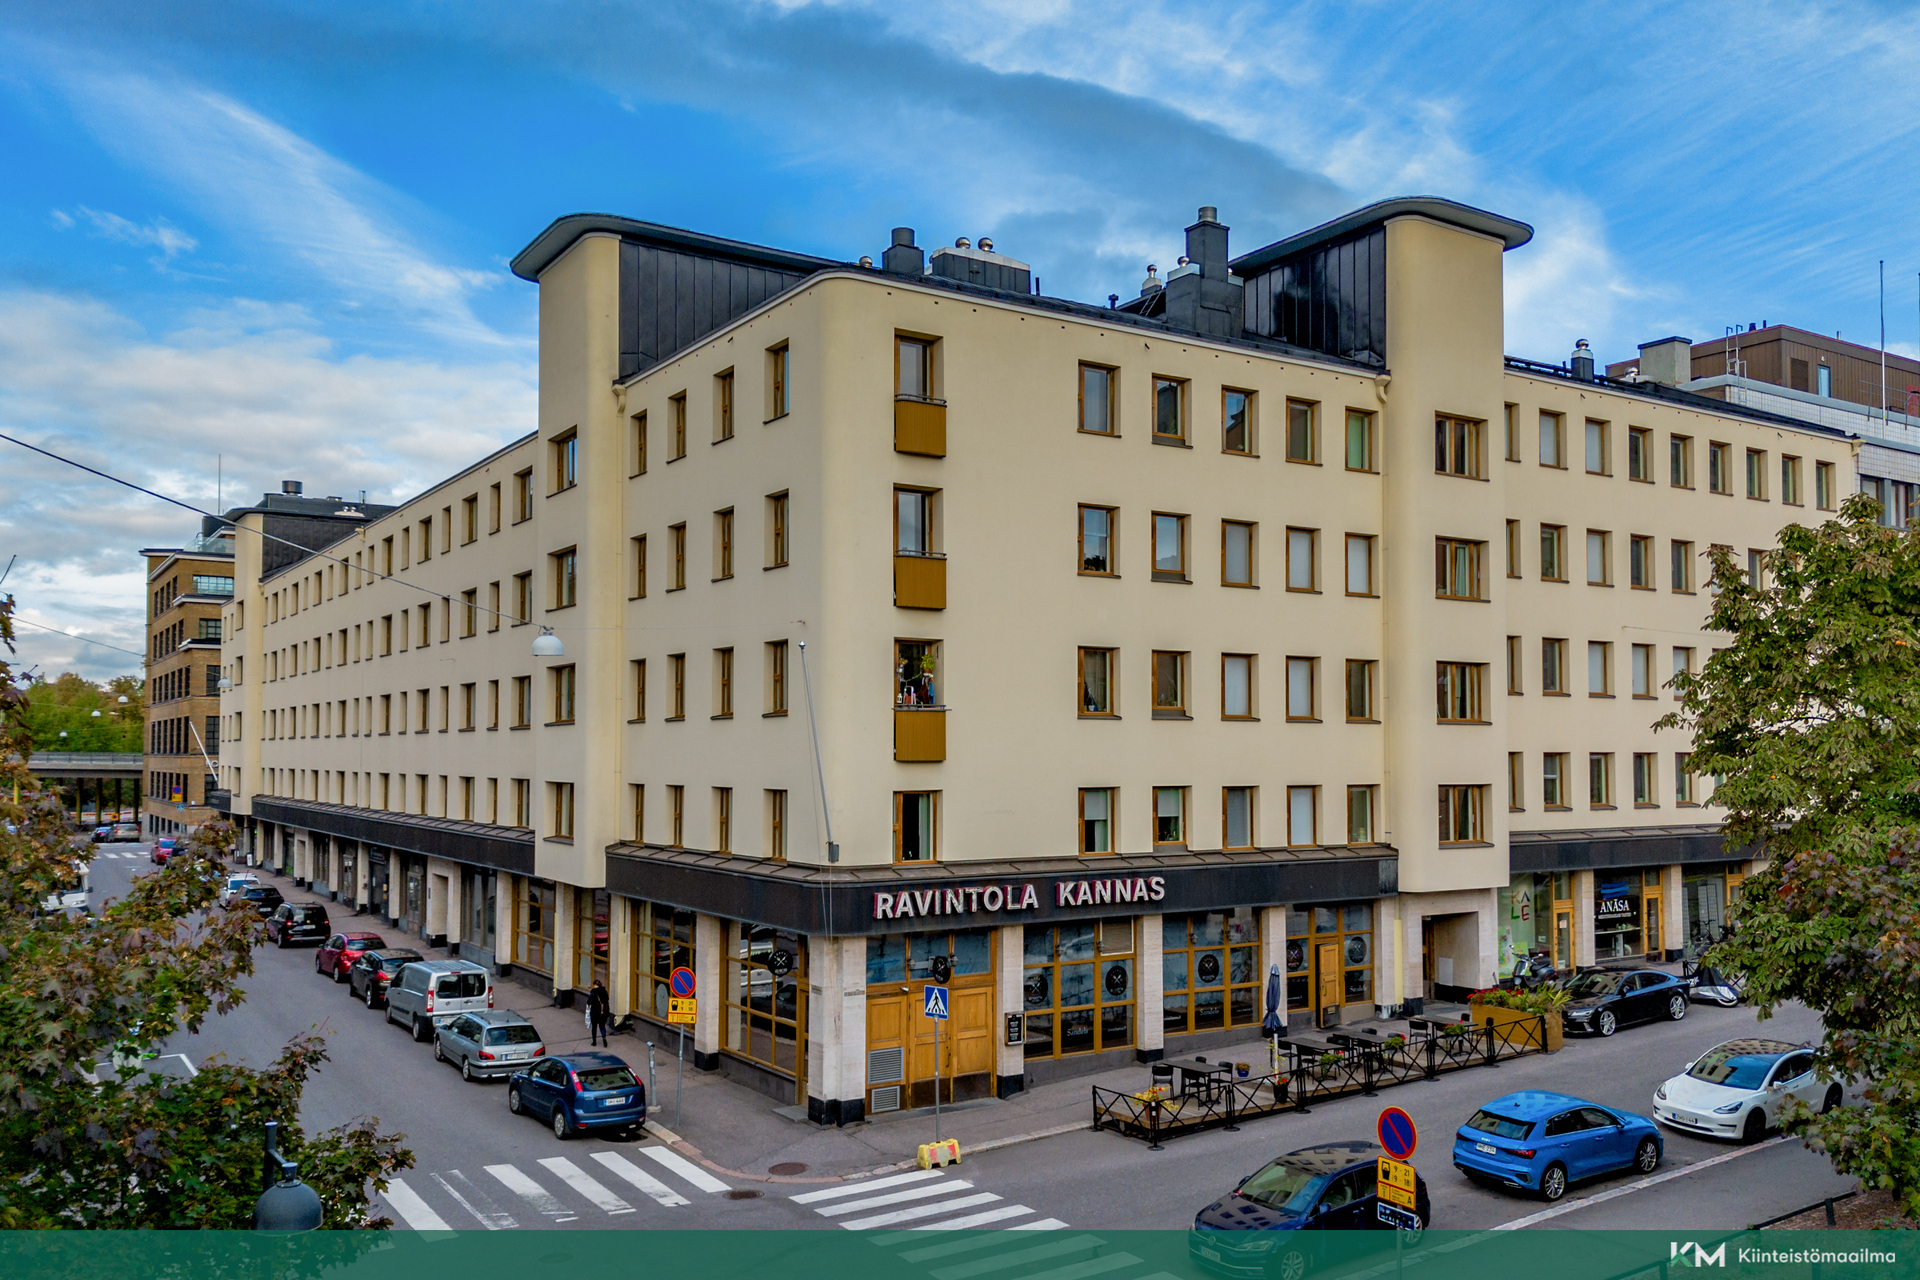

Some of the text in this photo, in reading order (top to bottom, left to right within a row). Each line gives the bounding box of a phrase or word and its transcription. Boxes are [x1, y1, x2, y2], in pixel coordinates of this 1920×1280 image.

[873, 876, 1165, 919] RAVINTOLA KANNAS
[1407, 1195, 1413, 1206] A
